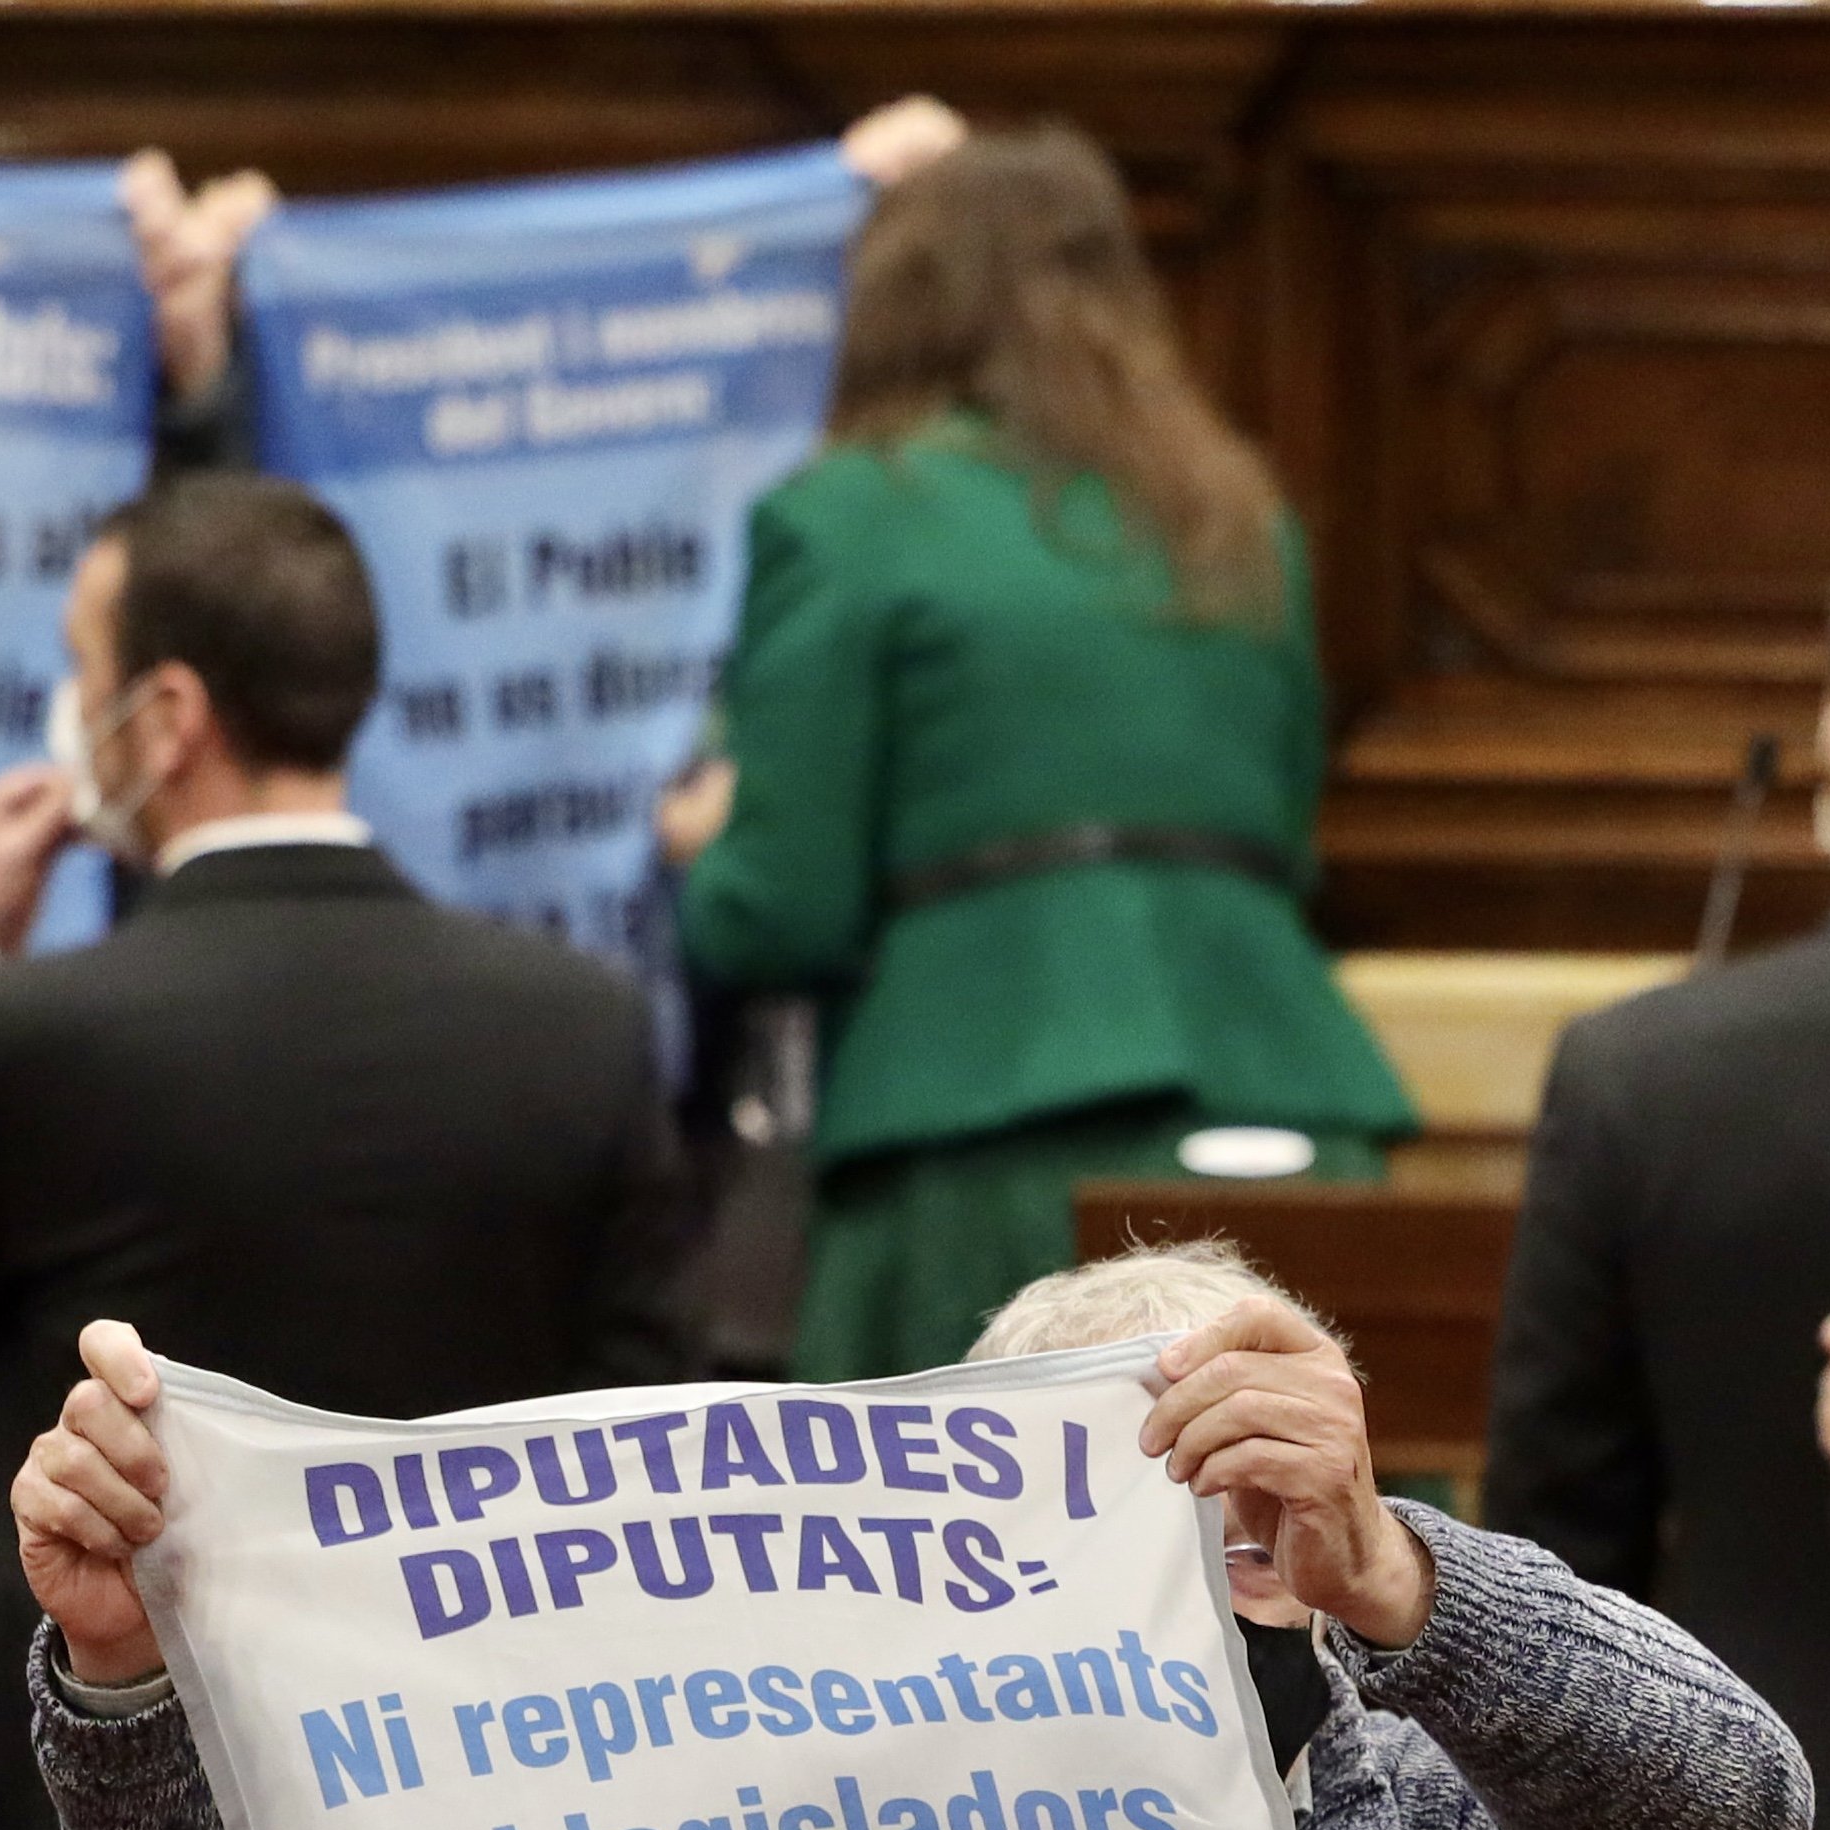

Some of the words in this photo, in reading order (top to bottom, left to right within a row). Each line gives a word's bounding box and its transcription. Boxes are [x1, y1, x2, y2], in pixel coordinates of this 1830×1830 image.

[304, 1400, 1024, 1547] DIPUTADES
[1063, 1421, 1096, 1520] I
[399, 1513, 1058, 1640] DIPUTATS:
[303, 1696, 420, 1806] Ni
[453, 1630, 1219, 1783] representants
